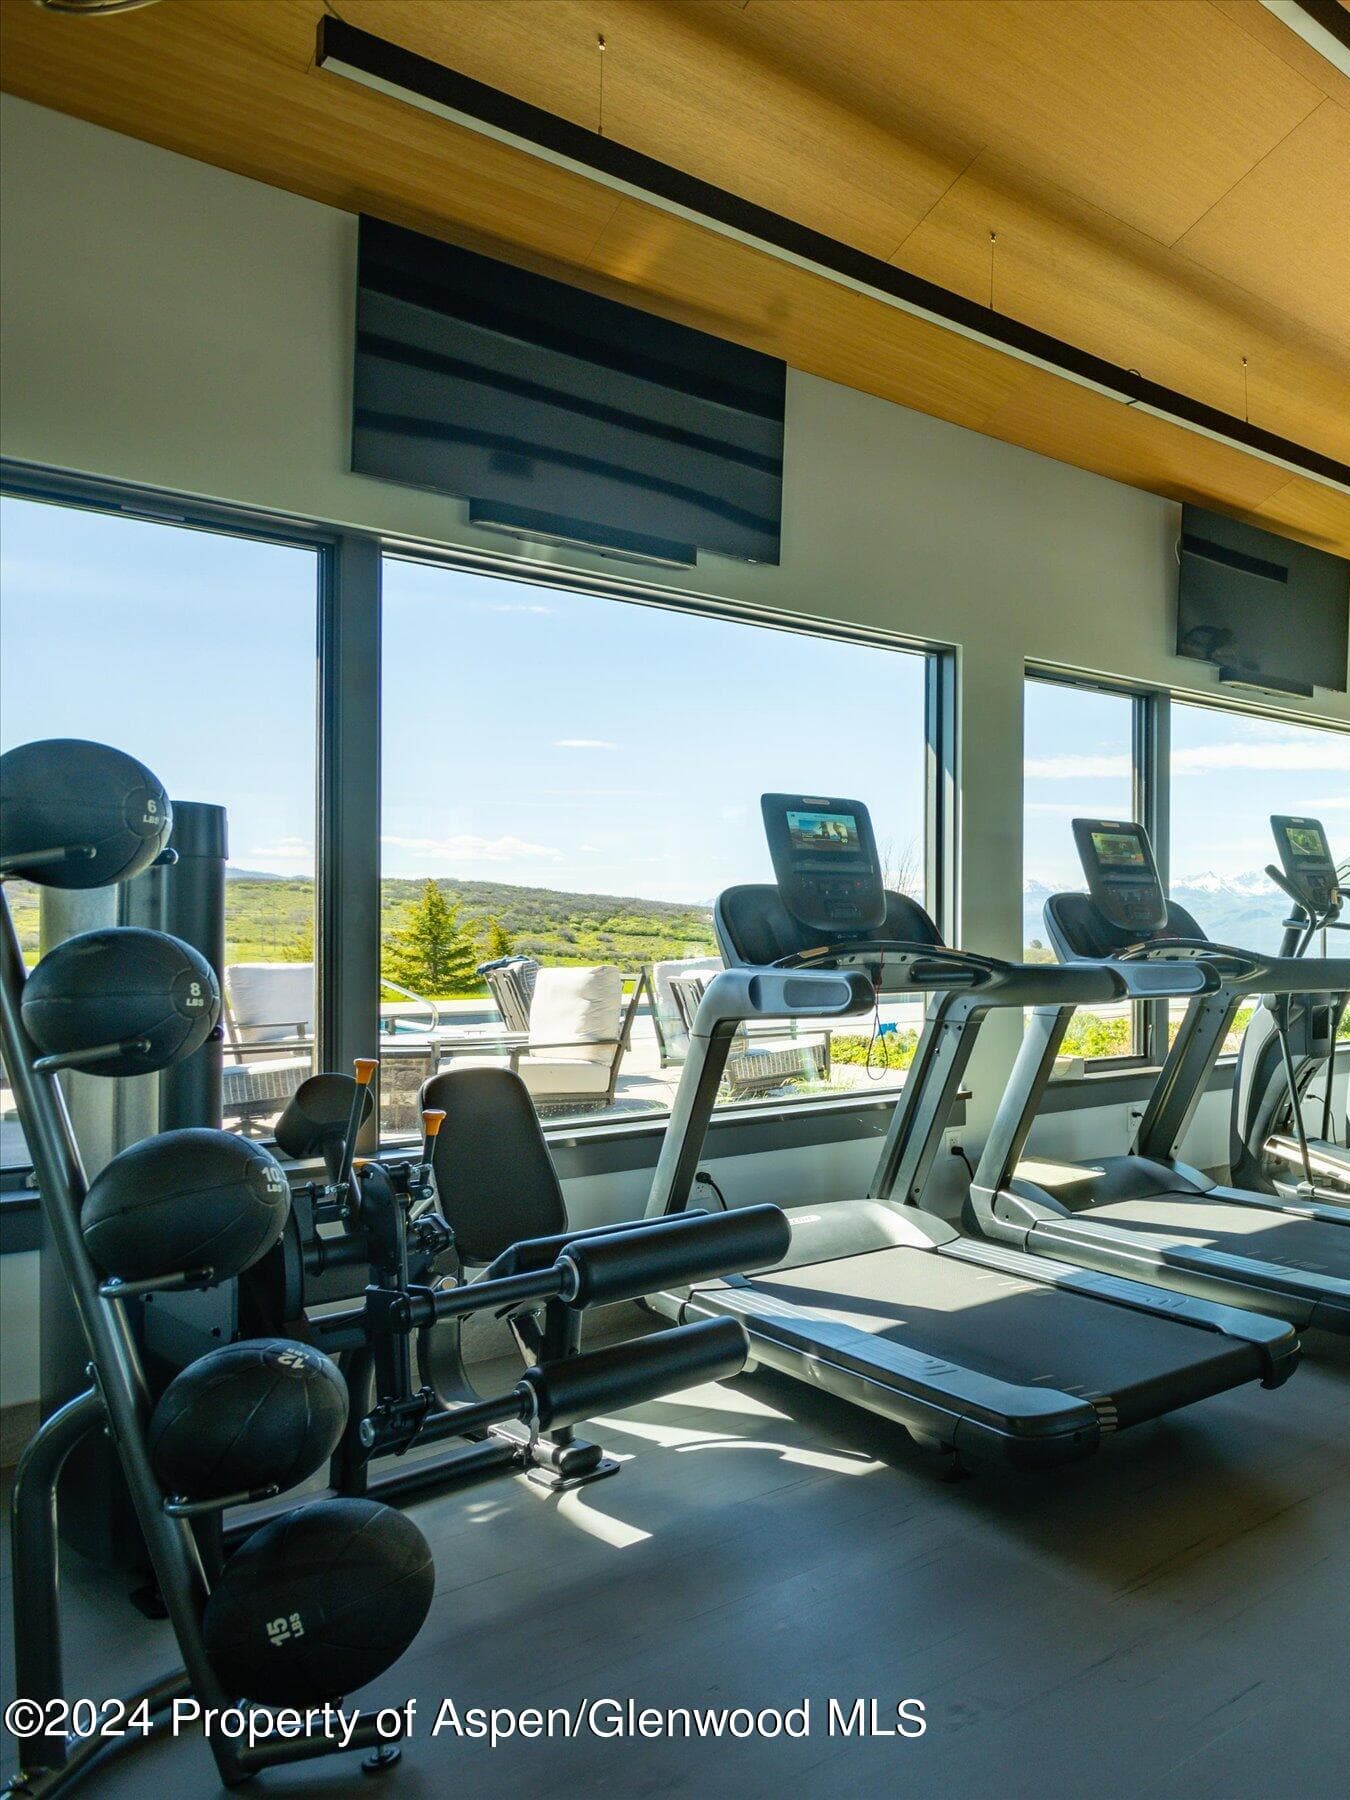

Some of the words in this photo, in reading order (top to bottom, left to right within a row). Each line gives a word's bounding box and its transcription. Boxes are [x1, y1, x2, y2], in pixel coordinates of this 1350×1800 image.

[147, 799, 157, 814] 6
[143, 814, 160, 825] LBS
[190, 982, 201, 997] 8
[186, 998, 204, 1007] LBS
[261, 1167, 281, 1183] 10
[278, 1352, 305, 1369] 12
[266, 1617, 291, 1647] 15
[289, 1612, 305, 1638] LBS
